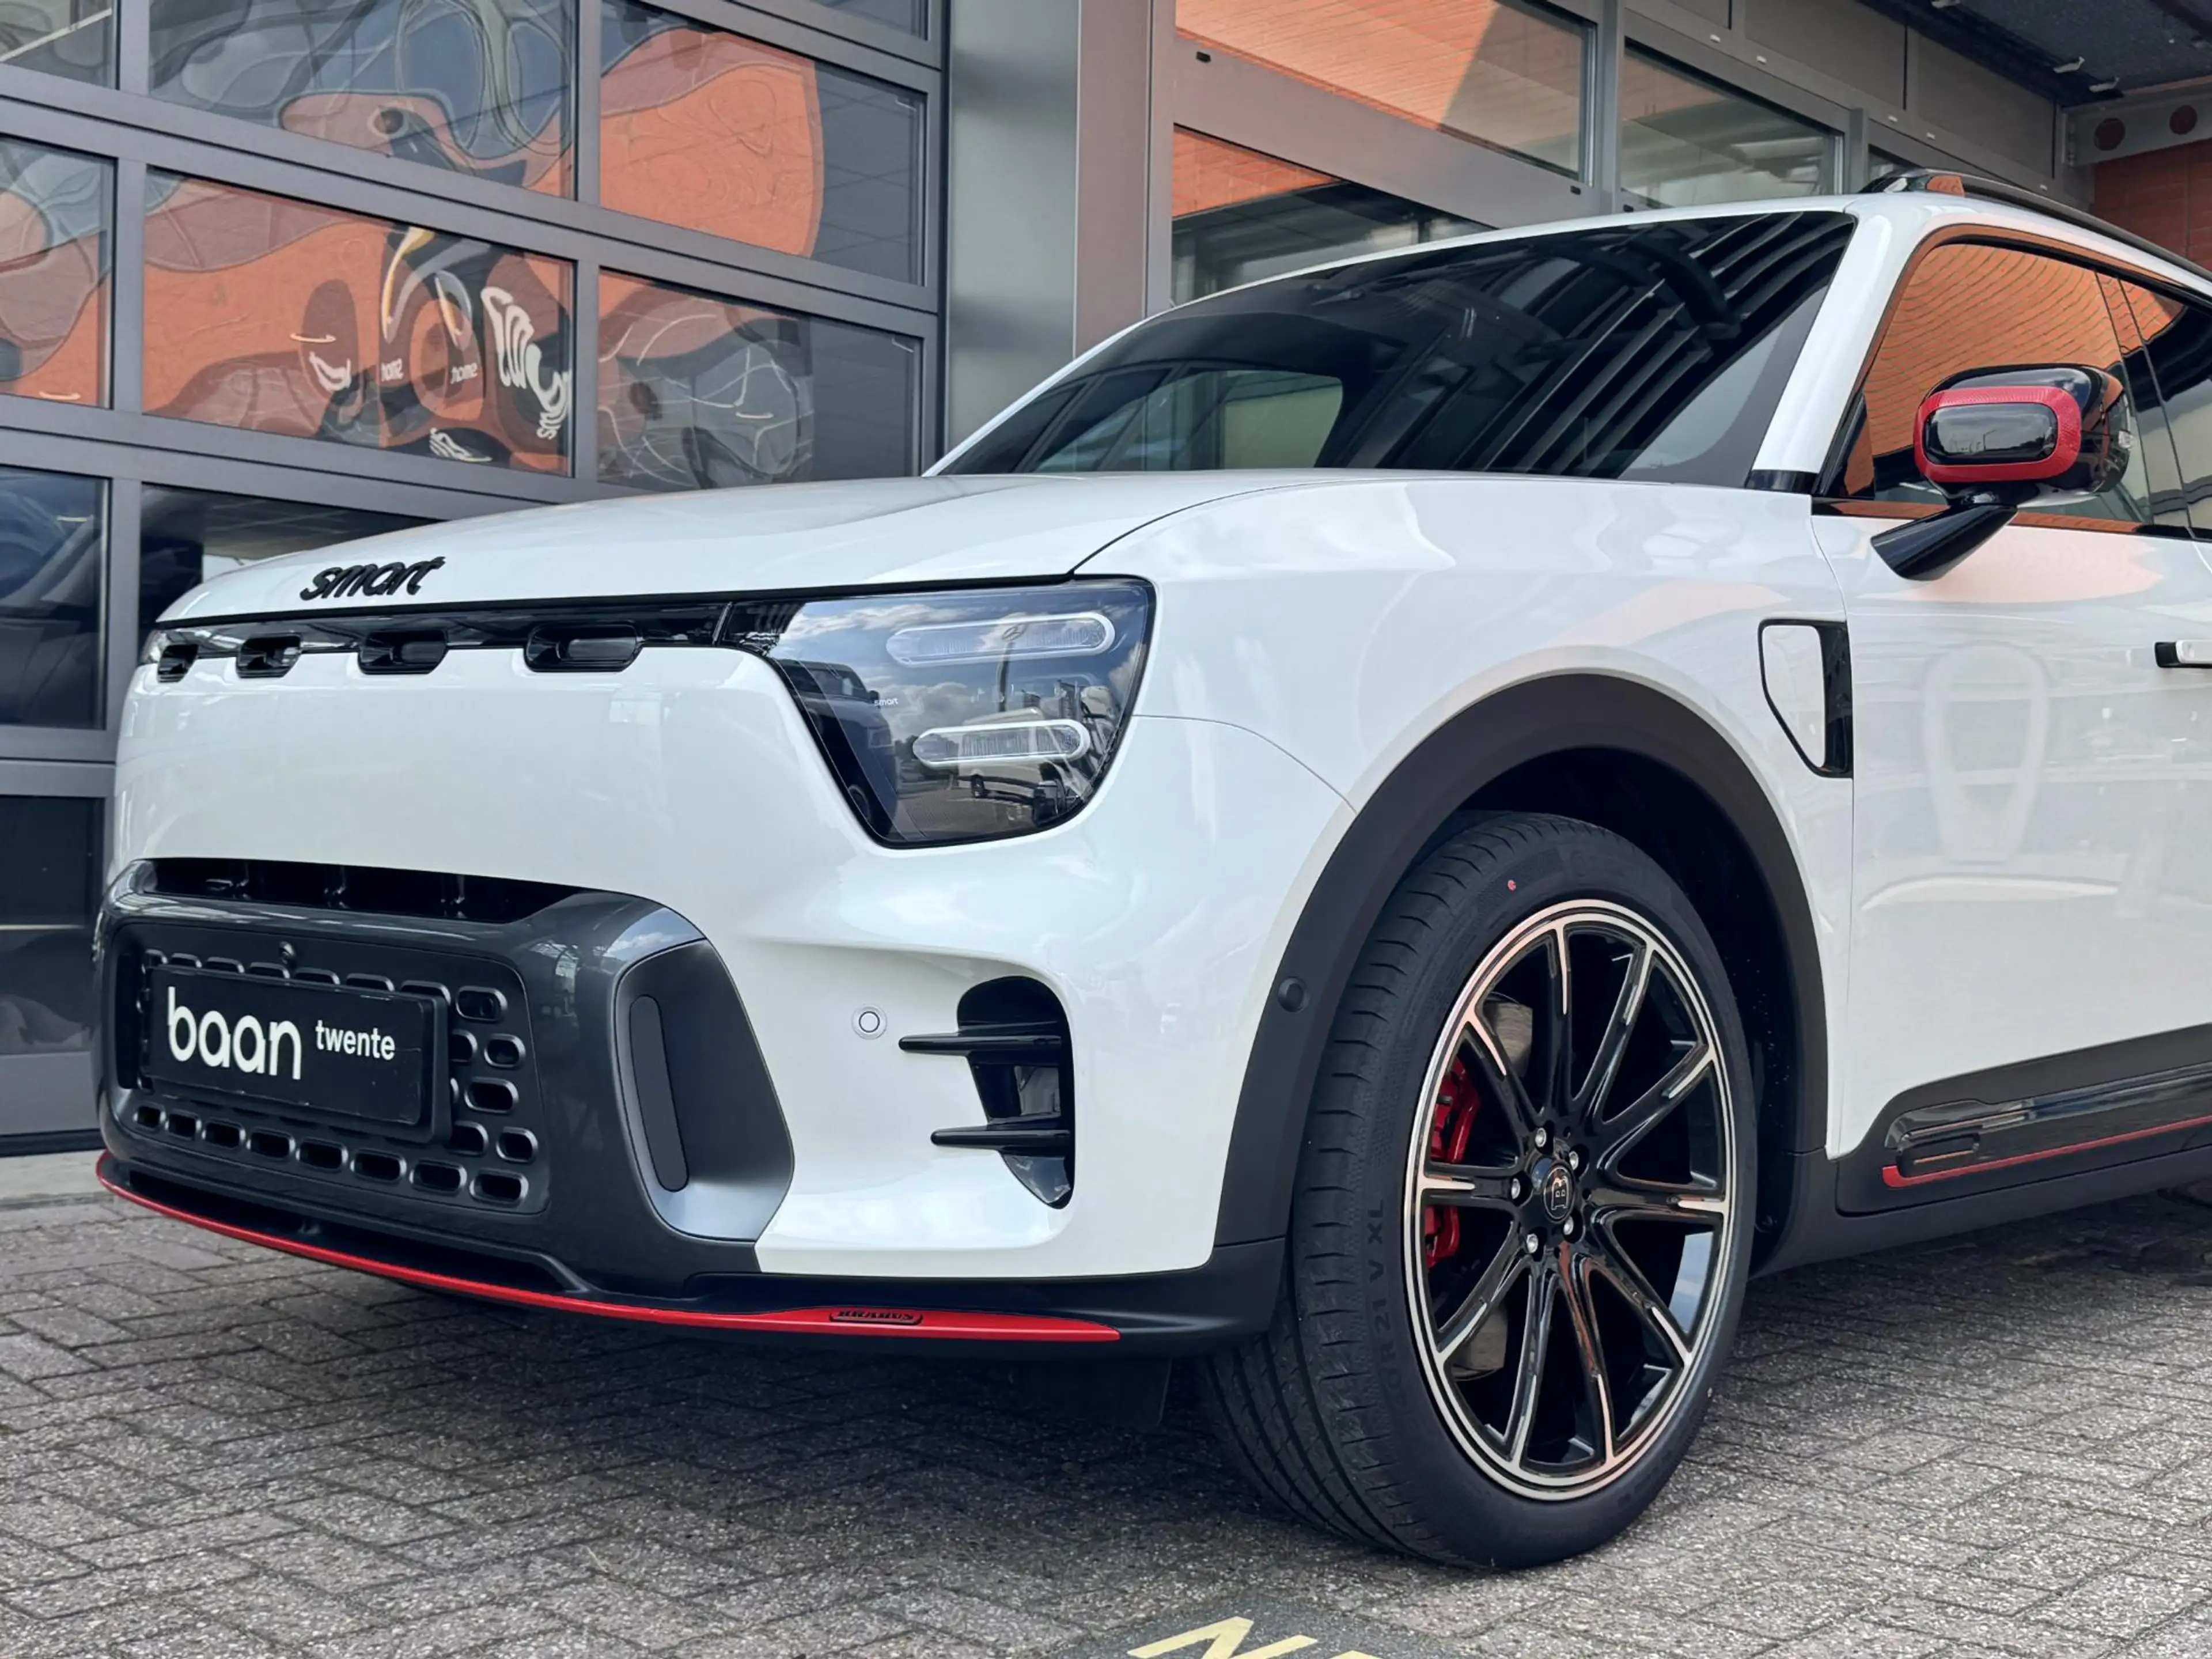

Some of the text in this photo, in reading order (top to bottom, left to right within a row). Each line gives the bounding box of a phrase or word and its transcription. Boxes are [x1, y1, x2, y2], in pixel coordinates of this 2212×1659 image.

[300, 555, 446, 601] smart
[167, 986, 396, 1080] baan twente
[838, 1310, 914, 1319] BRABUS
